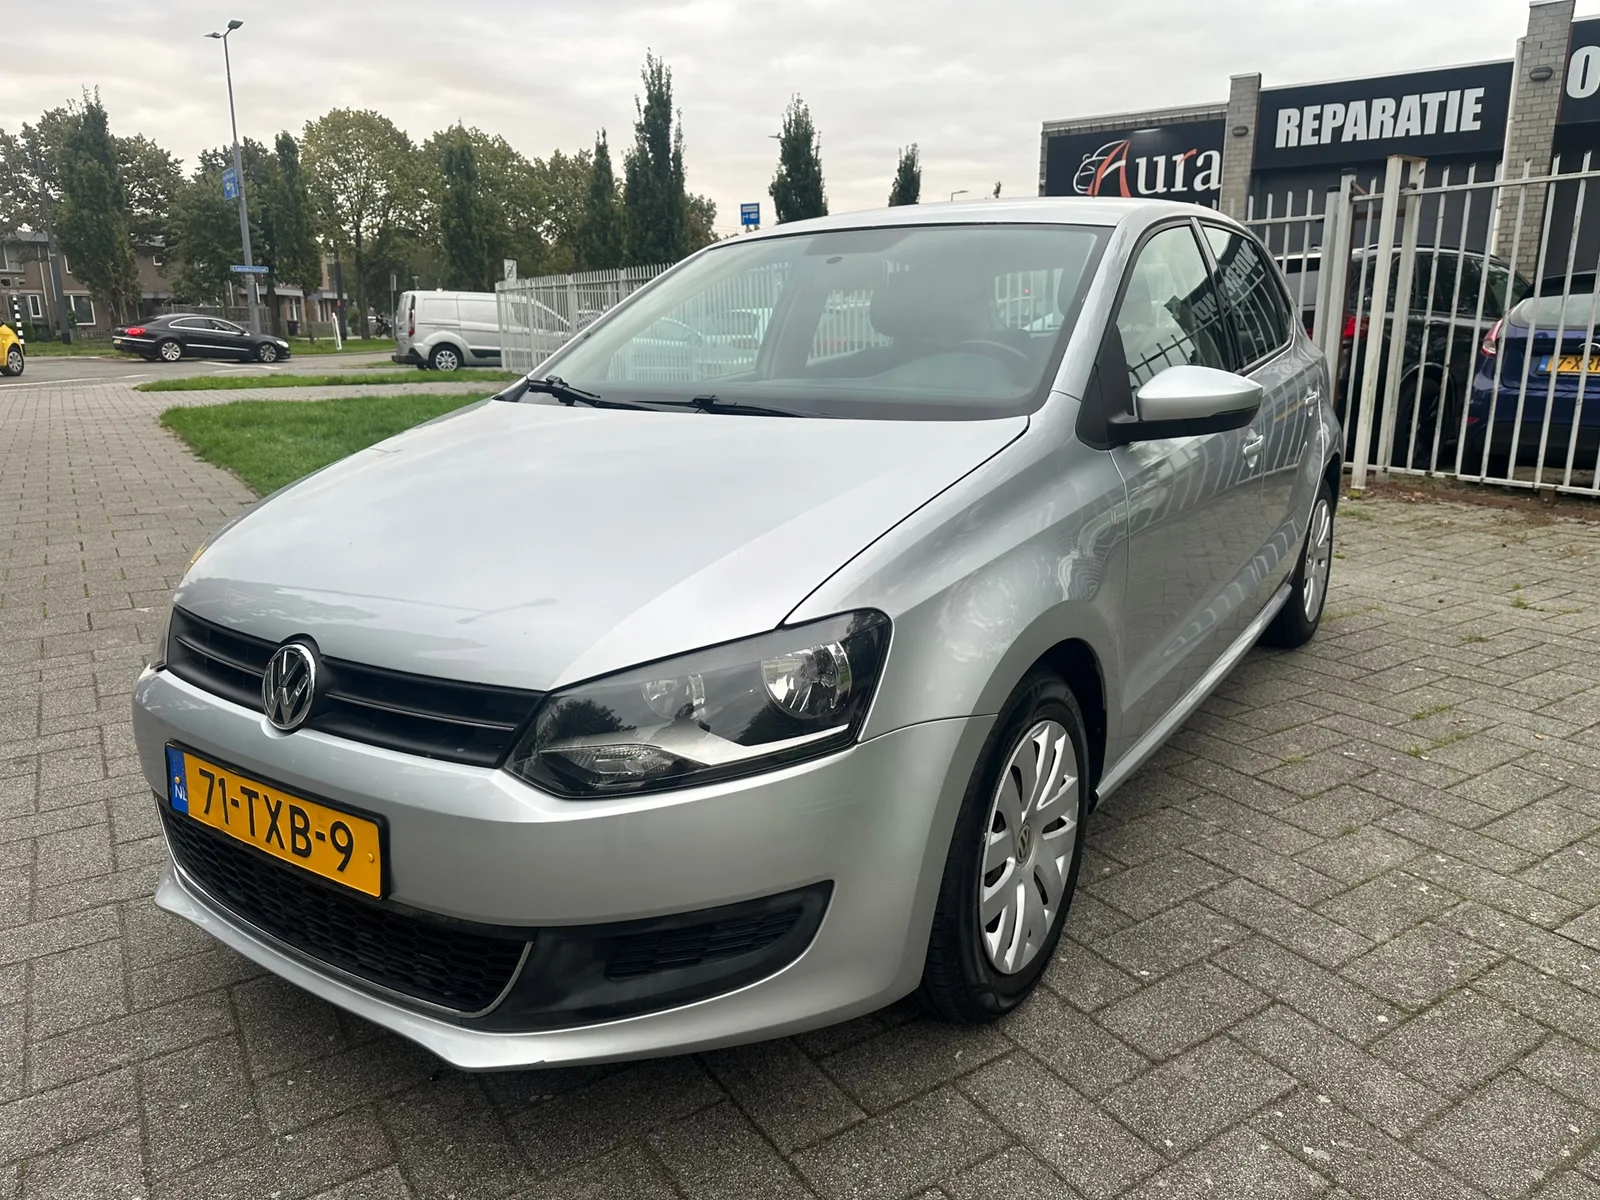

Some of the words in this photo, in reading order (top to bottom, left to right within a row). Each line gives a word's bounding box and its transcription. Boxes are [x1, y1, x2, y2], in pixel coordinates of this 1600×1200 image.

[1275, 87, 1485, 148] REPARATIE
[1086, 139, 1221, 197] Aura
[174, 784, 188, 802] NL
[199, 767, 354, 872] 71-TXB-9
